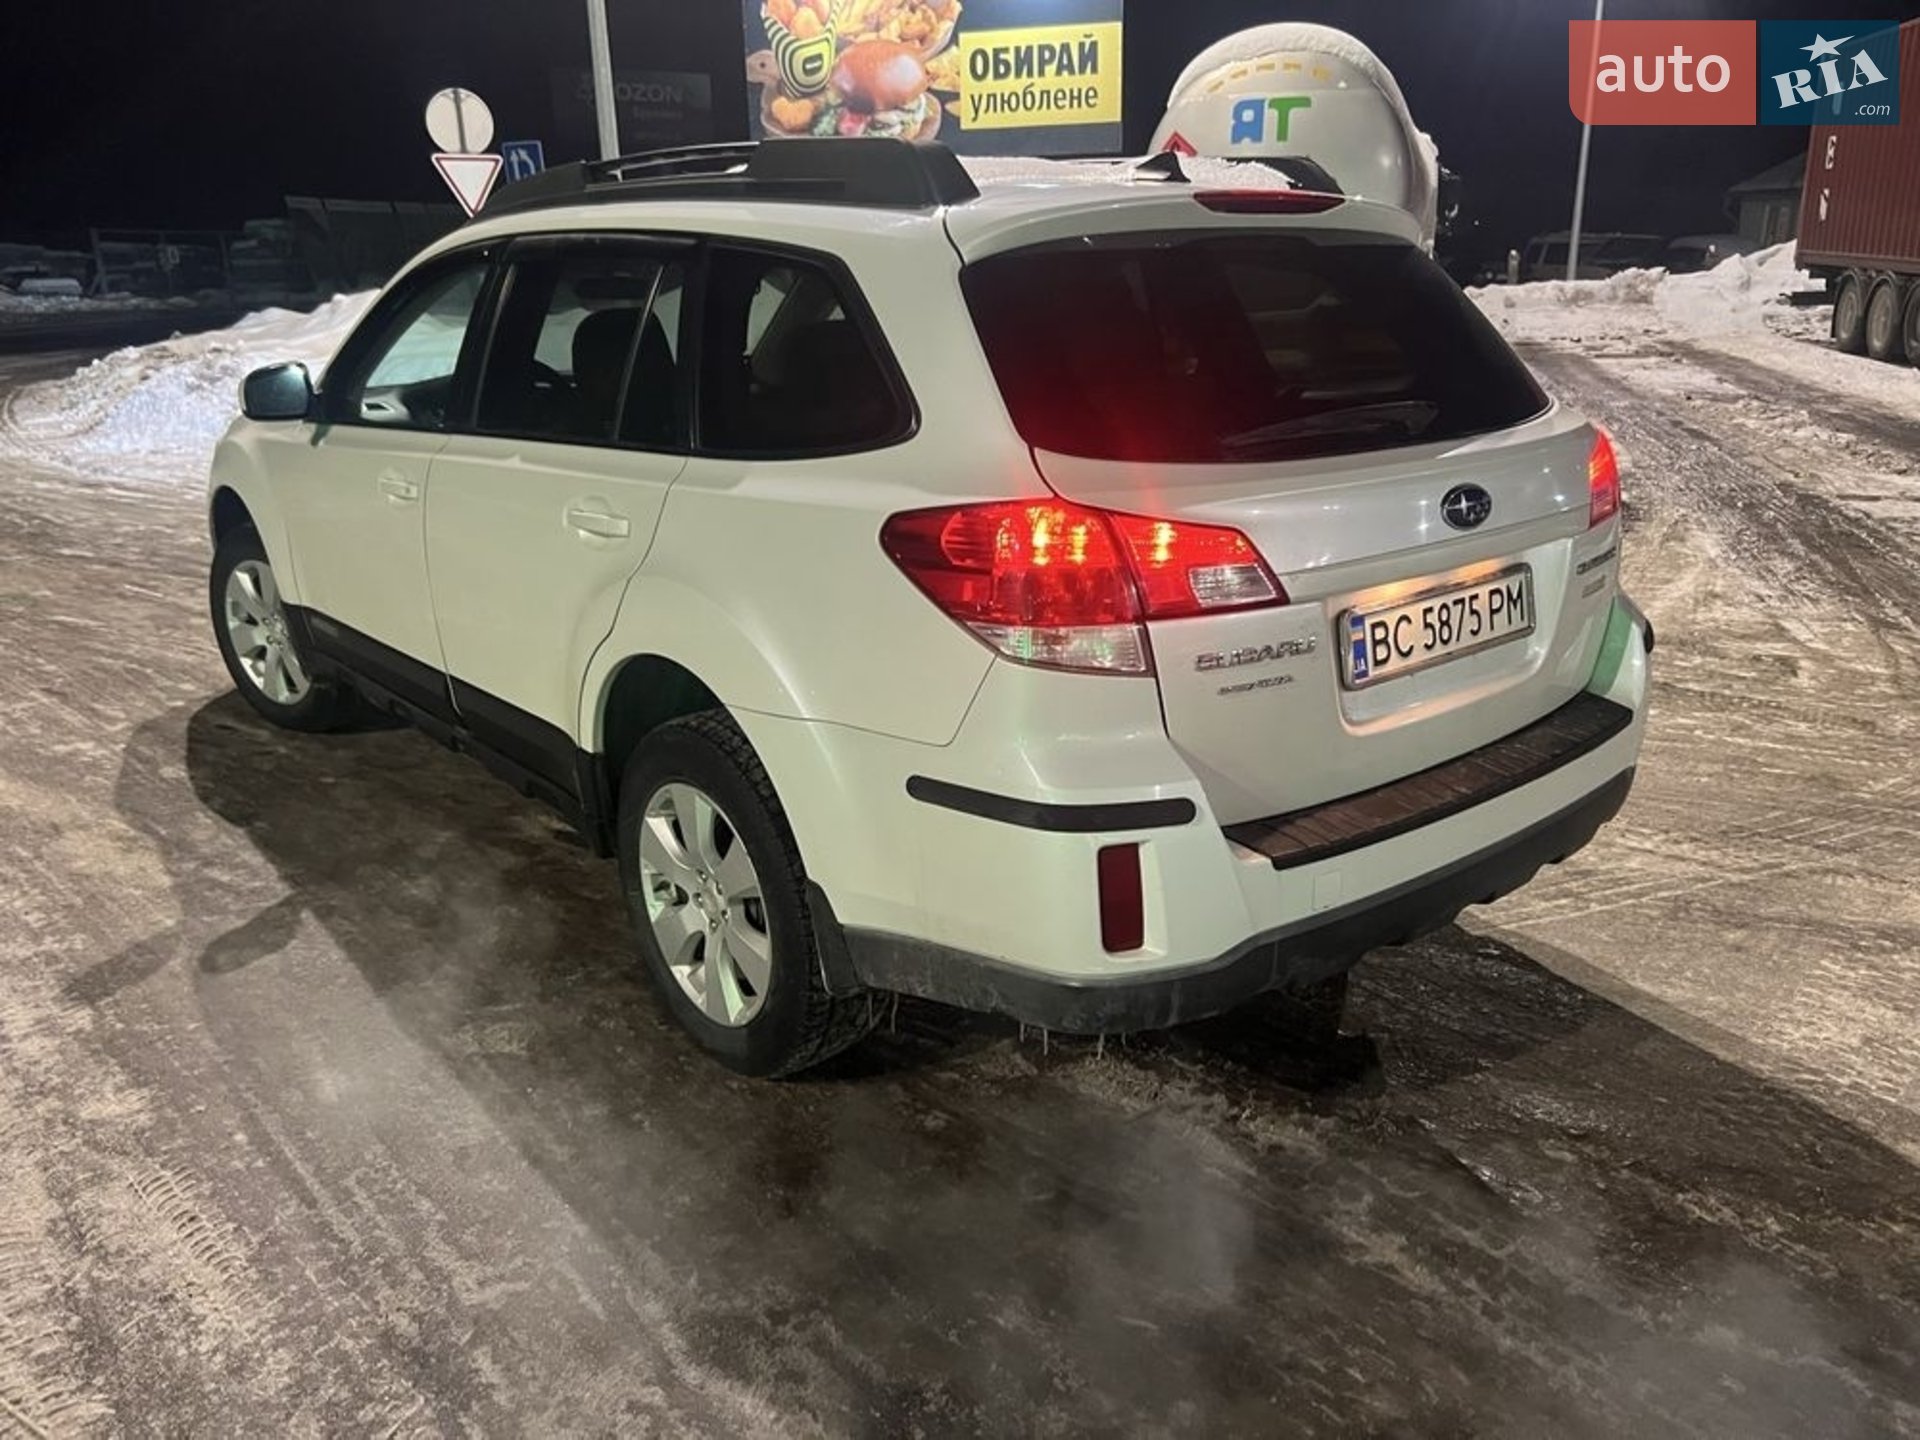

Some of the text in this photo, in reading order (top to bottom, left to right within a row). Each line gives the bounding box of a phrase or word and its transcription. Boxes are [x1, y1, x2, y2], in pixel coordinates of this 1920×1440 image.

[969, 33, 1099, 82] ОБИРАЙ
[970, 83, 1099, 122] улюблене
[1369, 613, 1415, 667] BC
[1422, 592, 1483, 651] 5875
[1488, 579, 1525, 632] PM
